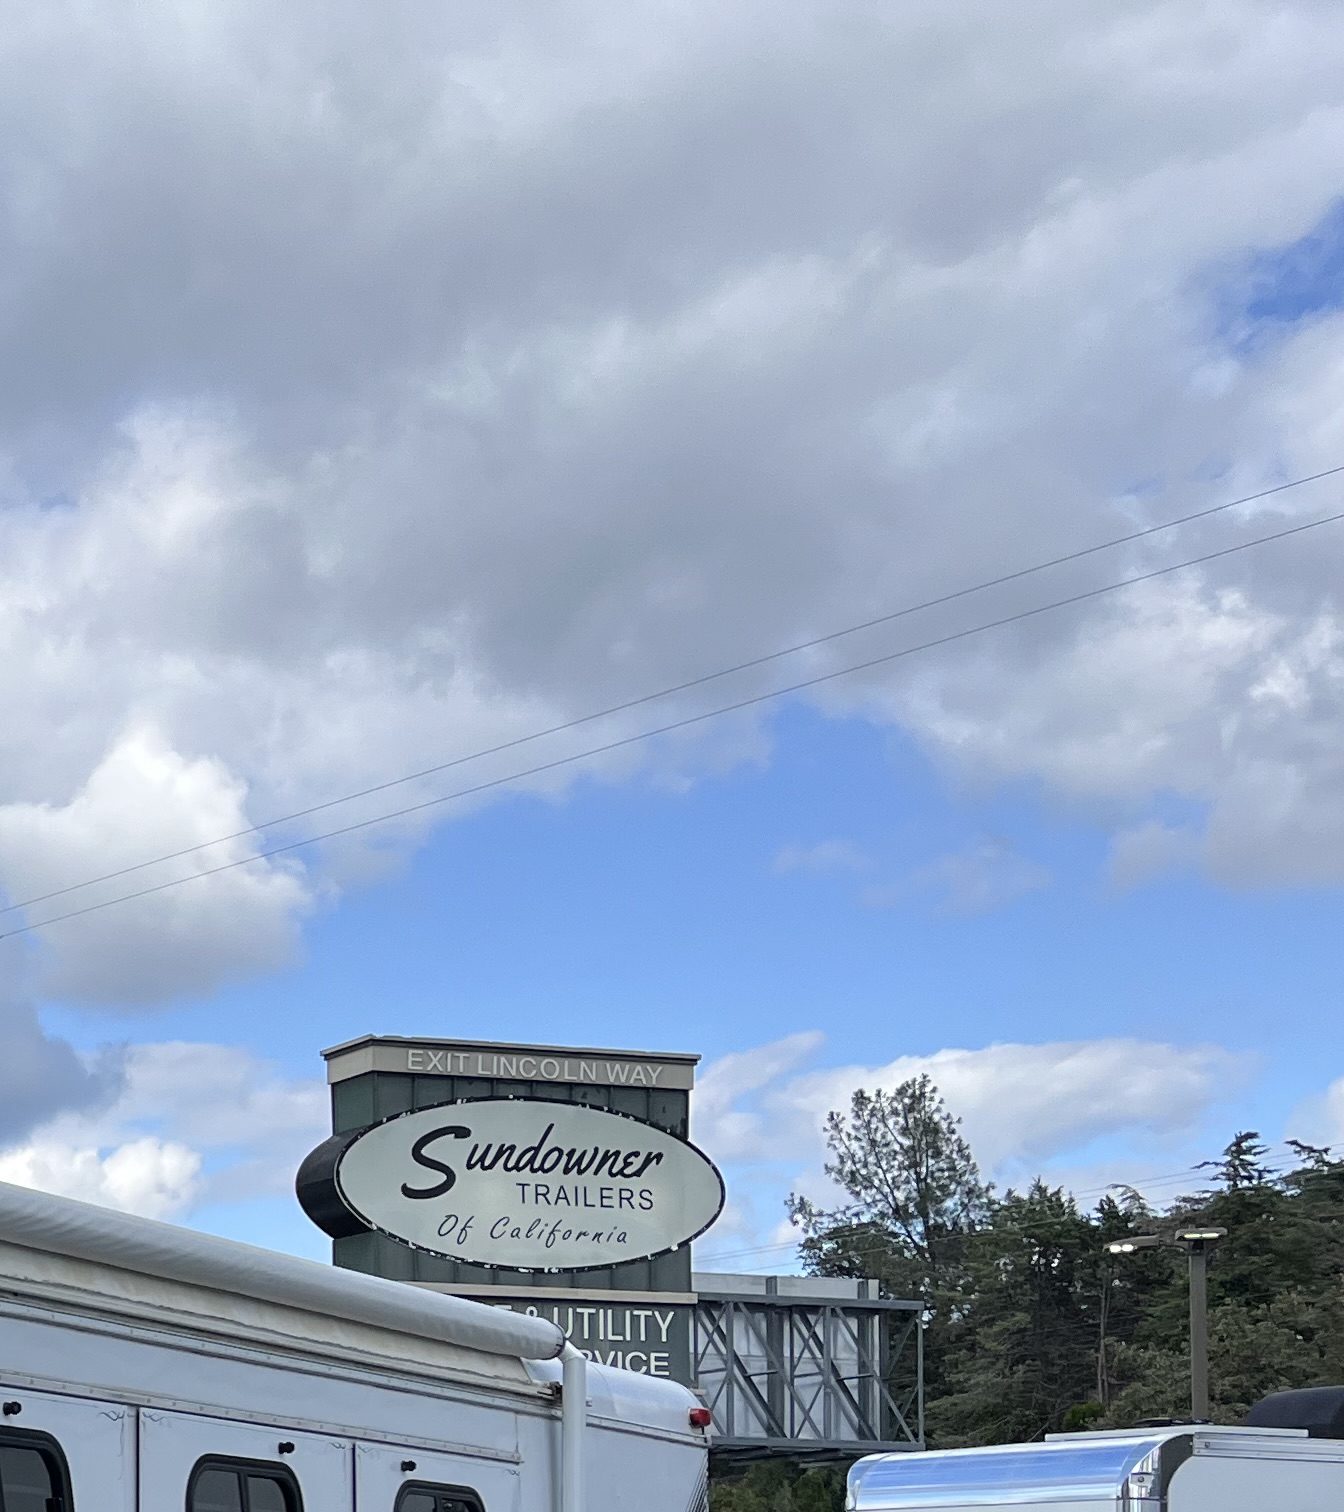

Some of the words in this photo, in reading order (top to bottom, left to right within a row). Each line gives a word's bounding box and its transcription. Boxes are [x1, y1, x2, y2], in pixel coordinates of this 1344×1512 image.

[407, 1049, 470, 1073] EXIT
[477, 1054, 597, 1082] LINCOLN
[604, 1062, 663, 1085] WAY
[401, 1123, 664, 1200] Sundowner
[516, 1182, 654, 1210] TRAILERS
[437, 1213, 474, 1245] Of
[489, 1216, 628, 1248] California
[553, 1306, 675, 1343] UTILITY
